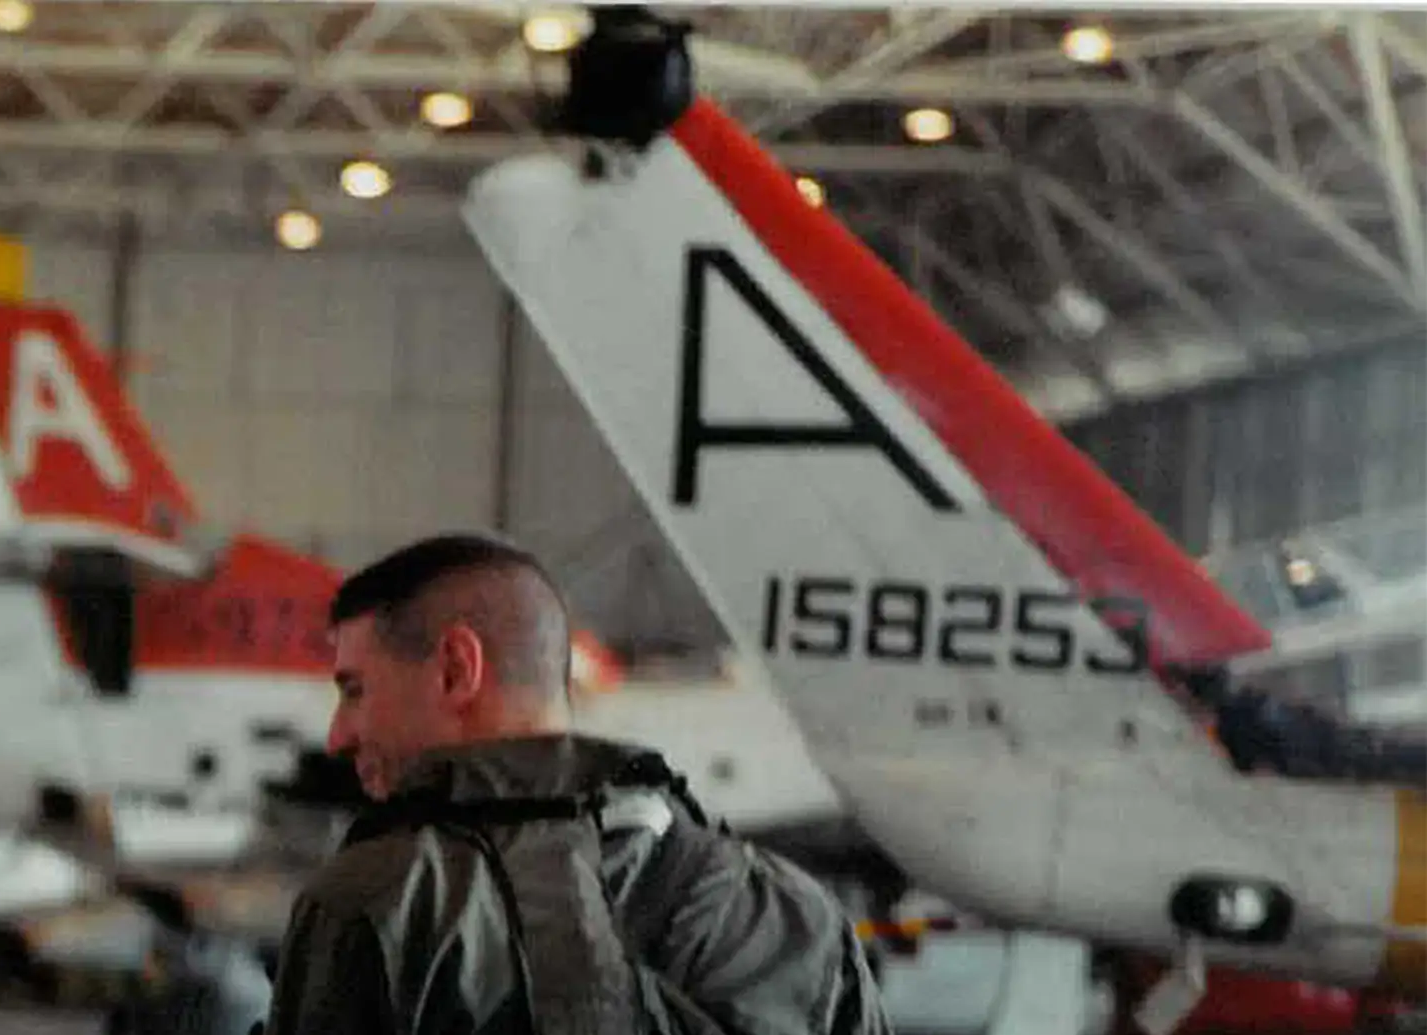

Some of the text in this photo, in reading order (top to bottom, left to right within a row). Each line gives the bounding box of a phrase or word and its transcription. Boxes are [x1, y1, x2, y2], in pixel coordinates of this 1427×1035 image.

[10, 331, 133, 490] A
[672, 245, 961, 512] A
[762, 575, 1147, 674] 158253
